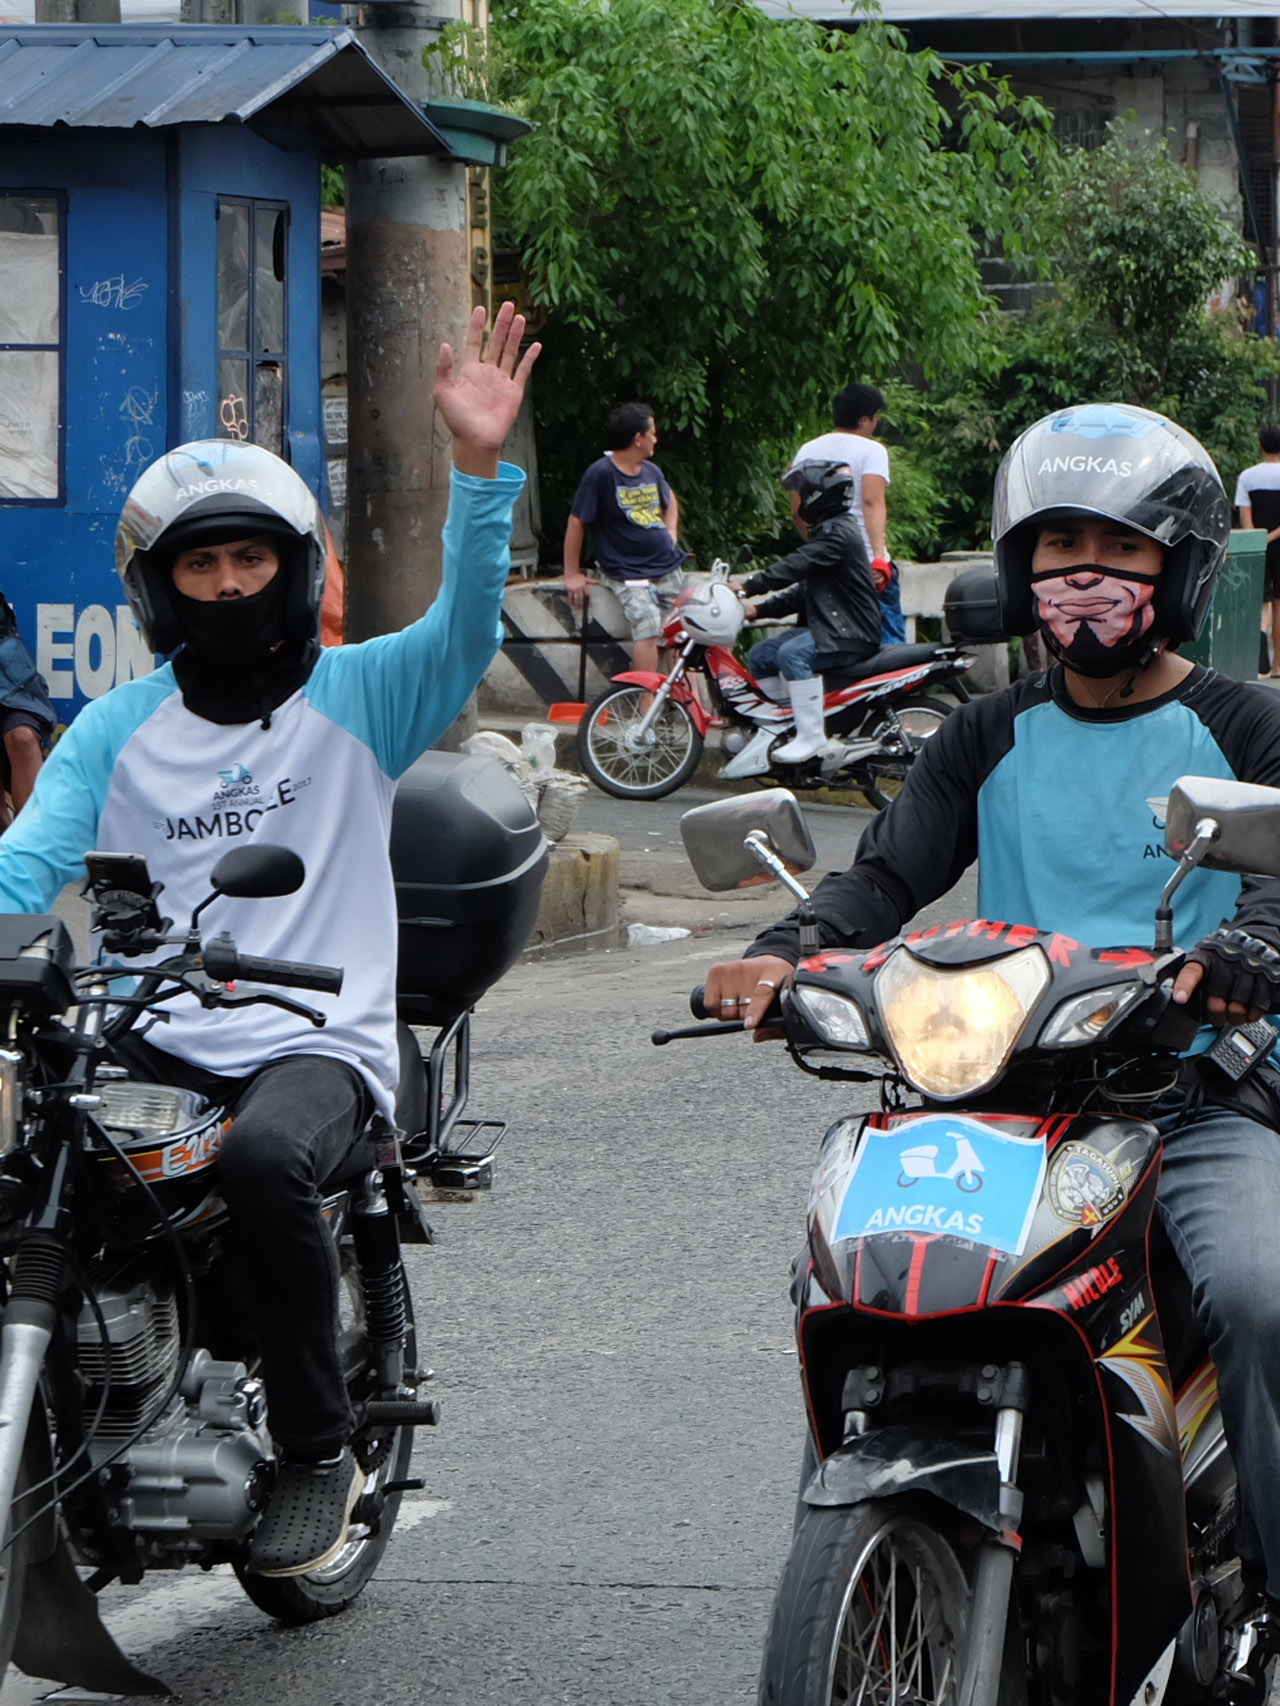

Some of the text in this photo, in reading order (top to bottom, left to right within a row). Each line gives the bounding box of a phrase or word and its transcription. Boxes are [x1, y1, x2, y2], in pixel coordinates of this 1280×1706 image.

[1037, 455, 1133, 478] ANGKAS
[175, 478, 260, 502] ANGKAS
[36, 603, 156, 700] EON
[166, 778, 297, 841] JAMBOE
[213, 785, 260, 801] ANGKAS
[865, 1204, 984, 1235] ANGKAS
[1062, 1256, 1123, 1311] NICOLE
[1119, 1292, 1145, 1335] SYM
